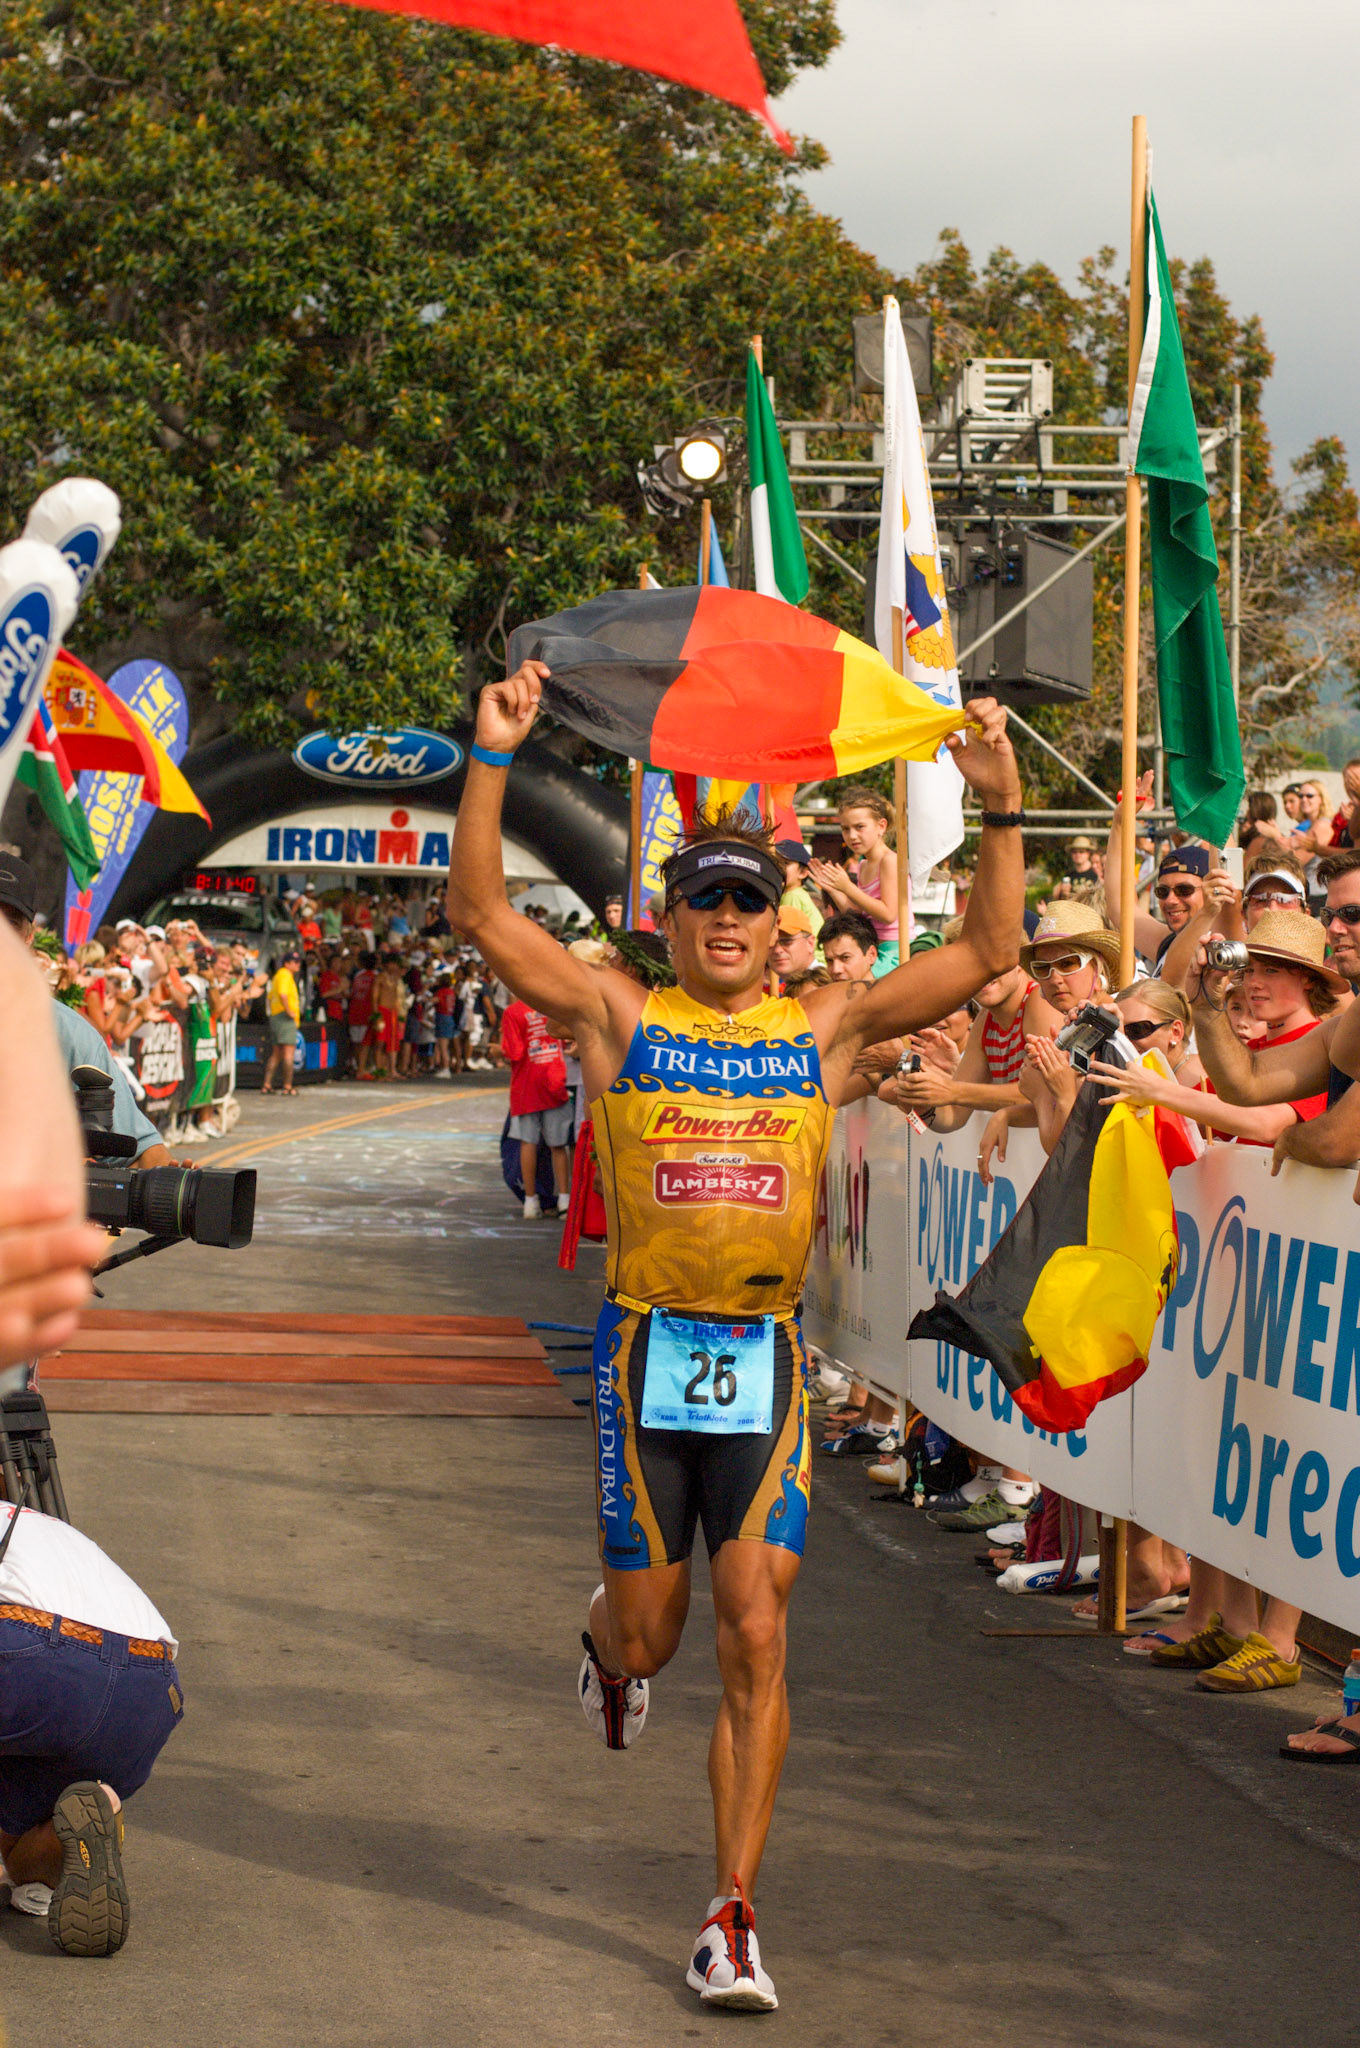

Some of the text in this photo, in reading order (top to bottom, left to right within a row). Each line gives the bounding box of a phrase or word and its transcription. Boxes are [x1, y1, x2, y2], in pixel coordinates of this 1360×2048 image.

[326, 731, 429, 776] Ford
[267, 825, 450, 867] IRONMA
[700, 857, 716, 866] TRI
[692, 1022, 766, 1035] KUOTA
[648, 1045, 811, 1081] TRI DUBAI
[652, 1105, 798, 1138] PowerBar
[693, 1323, 765, 1339] IRONMAN
[684, 1351, 737, 1406] 26
[599, 1360, 619, 1520] TRI DUBAI
[80, 1840, 91, 1869] KEEN
